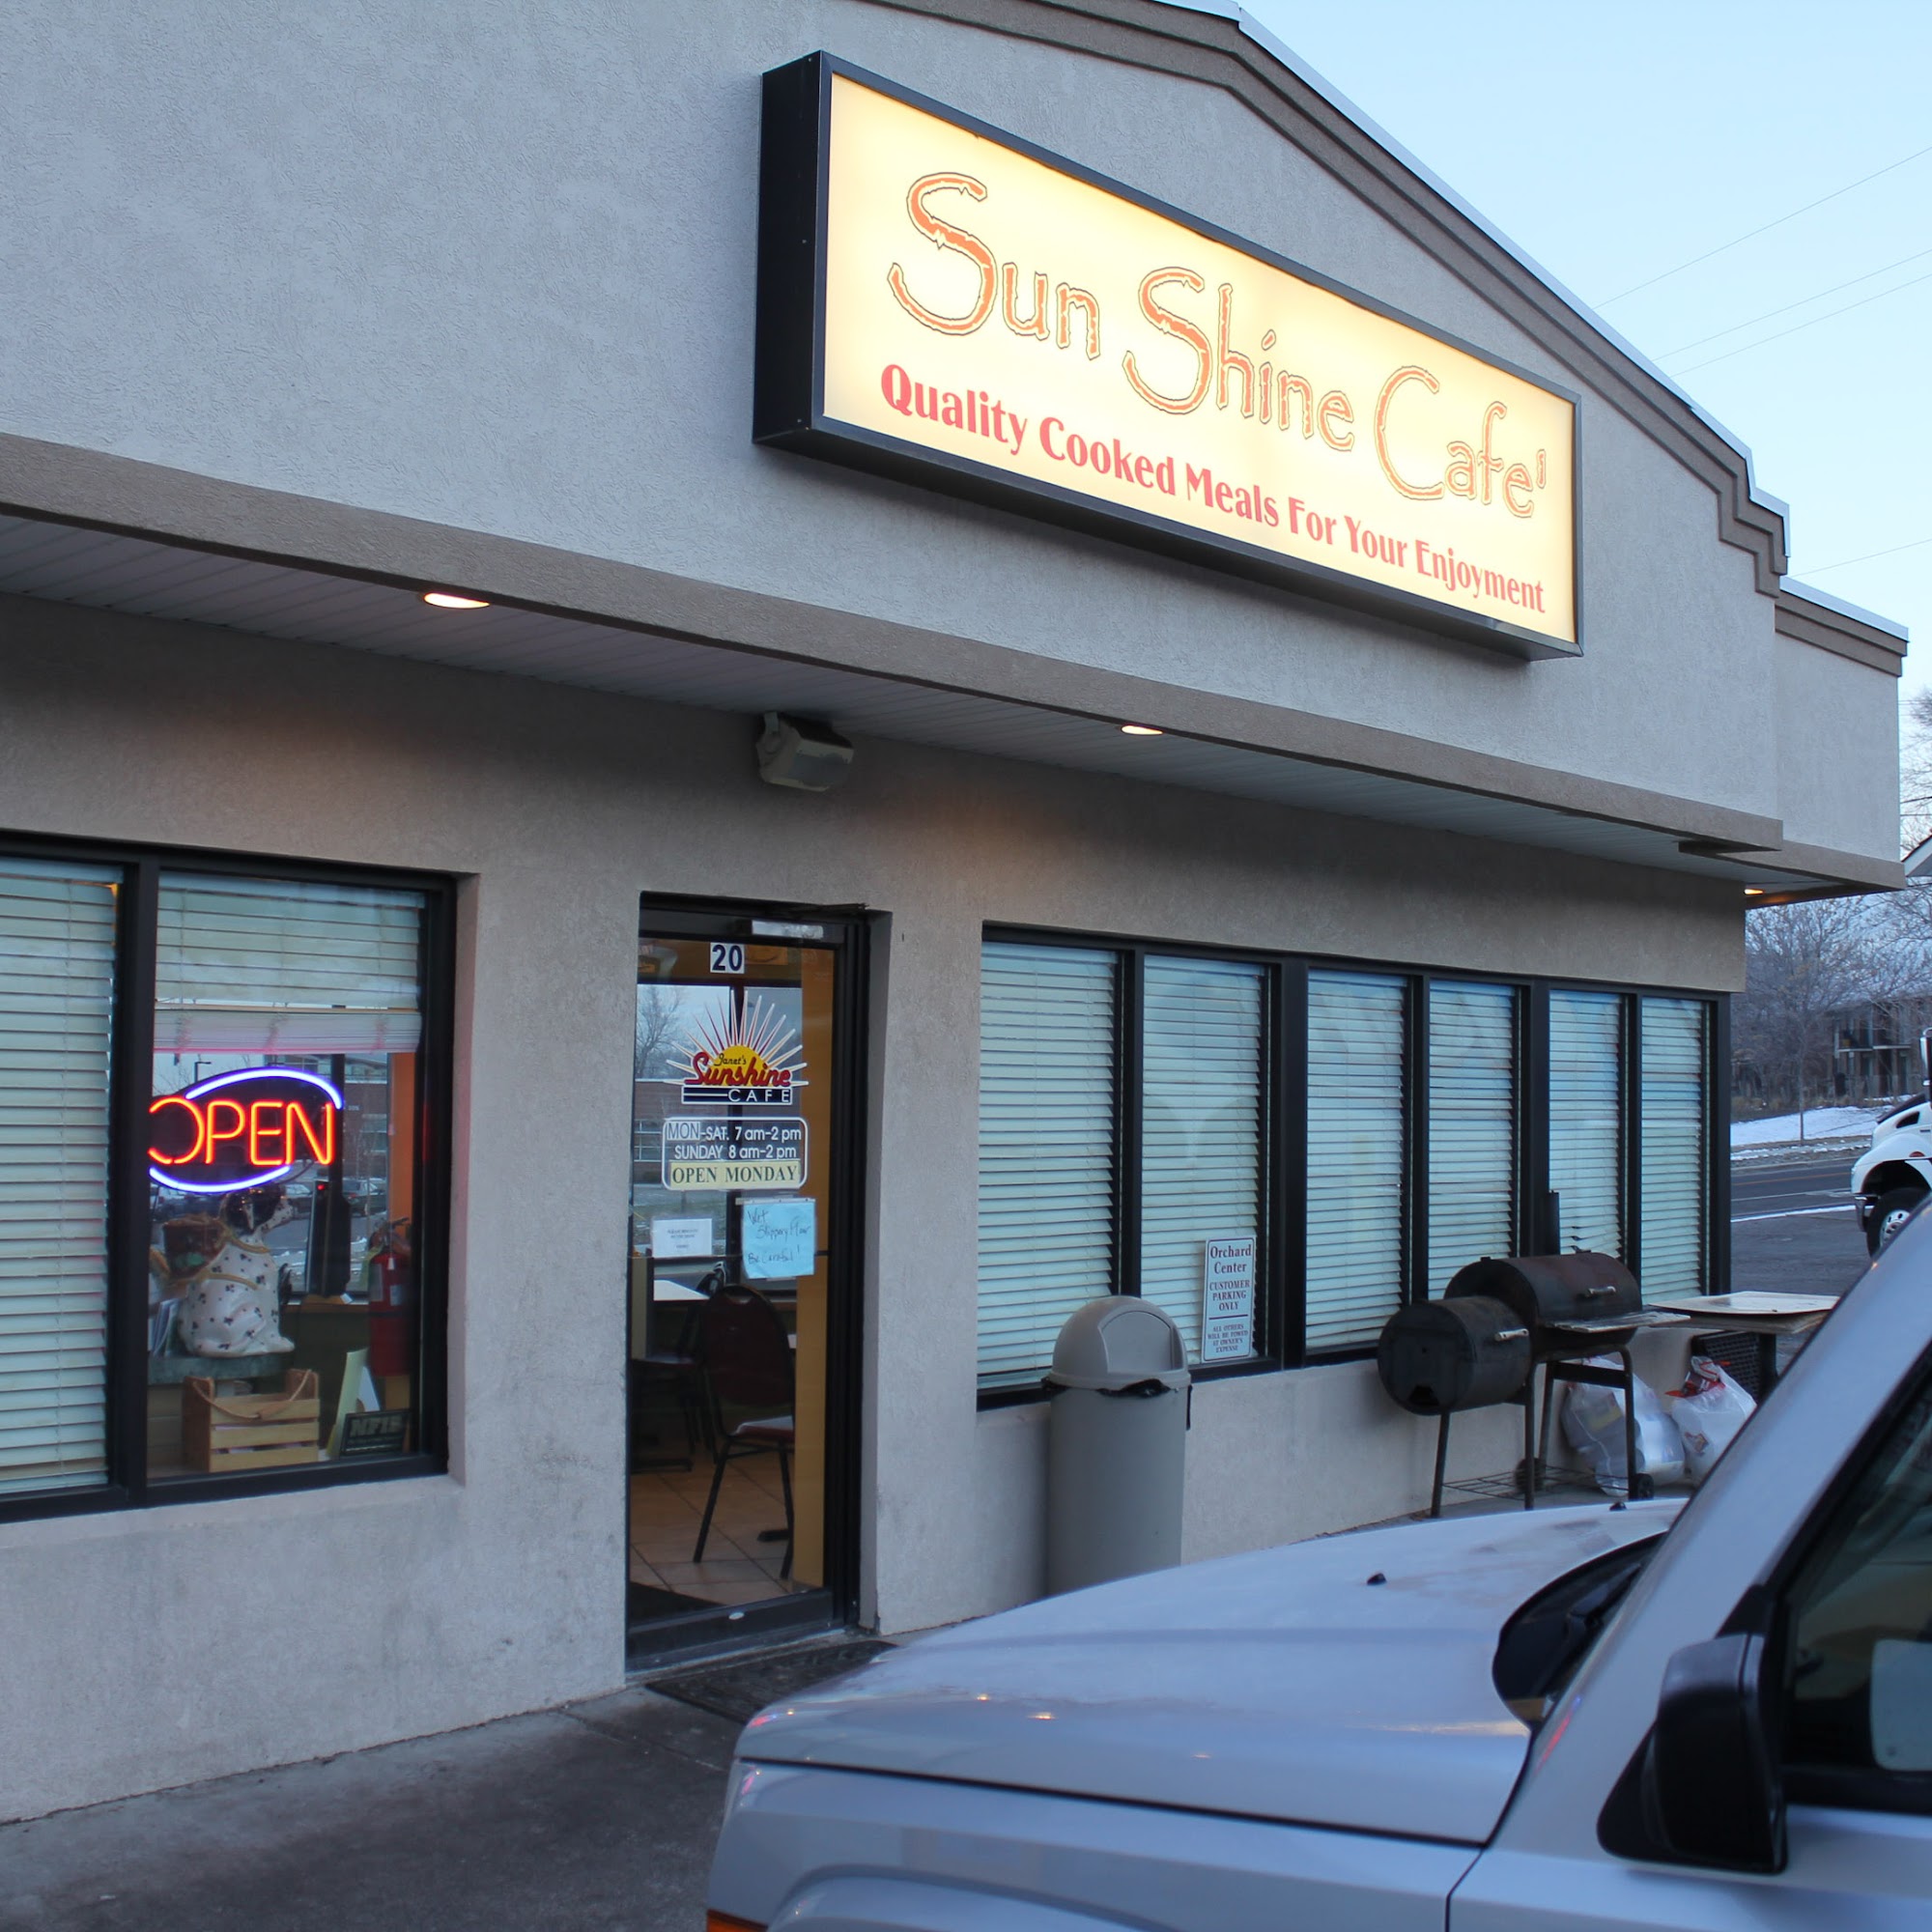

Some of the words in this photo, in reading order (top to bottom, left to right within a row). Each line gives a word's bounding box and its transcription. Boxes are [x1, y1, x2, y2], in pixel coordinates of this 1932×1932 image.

[887, 172, 1100, 360] Sun
[1122, 267, 1354, 451] Shine
[881, 364, 1028, 456] Quality
[1039, 417, 1176, 496] Cooked
[1185, 463, 1279, 527] Meals
[1289, 497, 1337, 545] For
[1344, 515, 1407, 568] Your
[1415, 539, 1546, 613] Enjoyment
[712, 944, 743, 972] 20
[713, 1053, 747, 1066] Janet's
[684, 1052, 791, 1087] Sunshine
[728, 1089, 790, 1102] CAFE
[148, 1095, 334, 1165] OPEN
[735, 1126, 742, 1141] 7
[781, 1128, 802, 1143] pm
[674, 1146, 724, 1159] SUNDAY
[728, 1145, 736, 1159] 8
[776, 1147, 797, 1159] pm
[672, 1167, 718, 1183] OPEN
[725, 1165, 797, 1182] MONDAY
[1209, 1244, 1251, 1259] Orchard
[1214, 1261, 1247, 1274] Center
[1209, 1280, 1250, 1291] CUSTOMER
[1212, 1291, 1247, 1301] PARKING
[1219, 1301, 1239, 1312] ONLY
